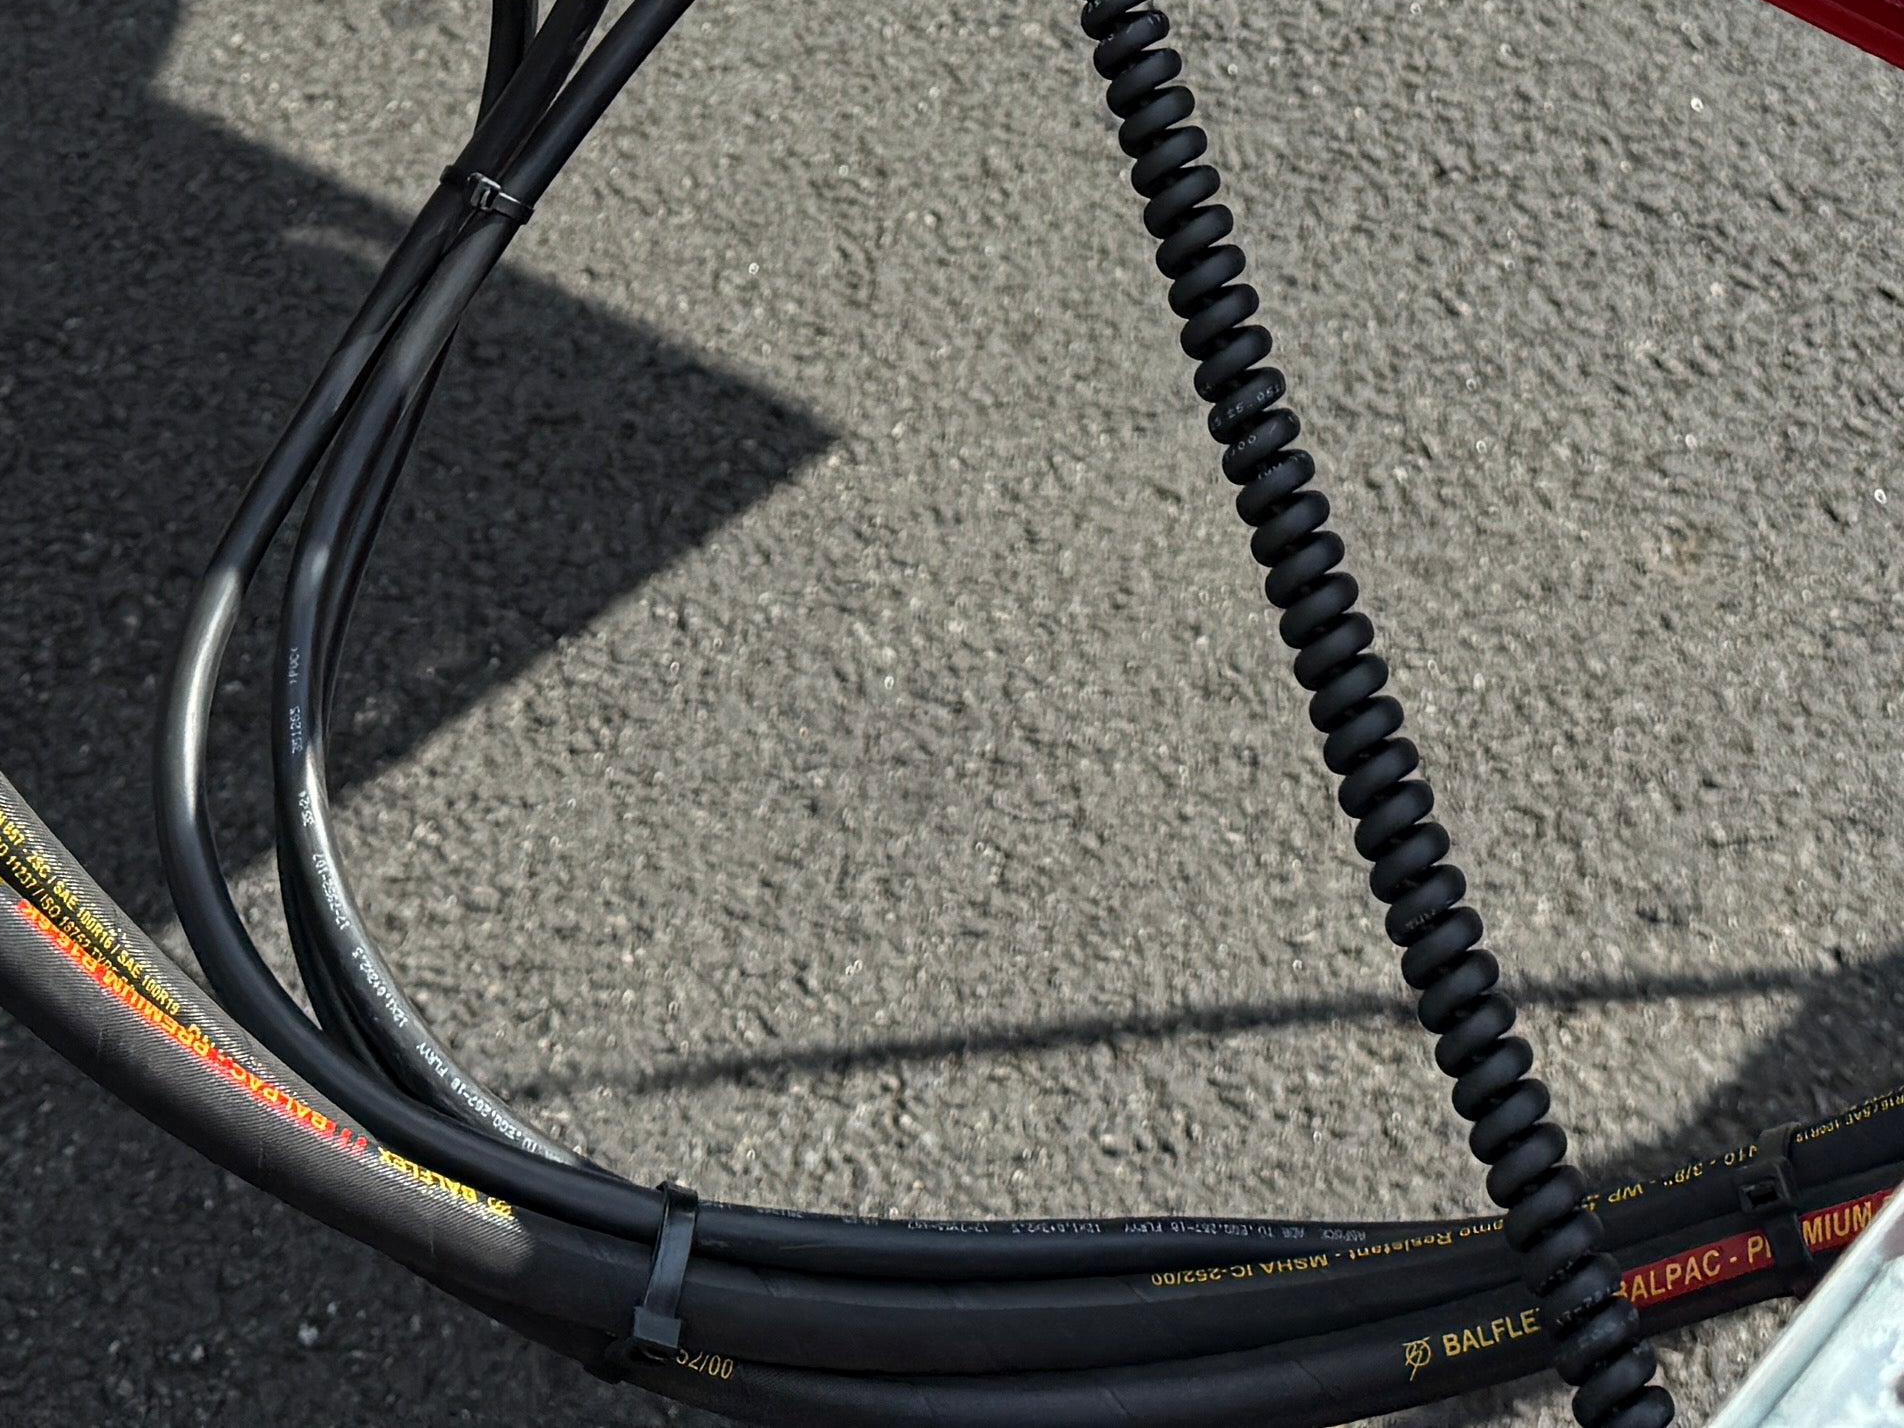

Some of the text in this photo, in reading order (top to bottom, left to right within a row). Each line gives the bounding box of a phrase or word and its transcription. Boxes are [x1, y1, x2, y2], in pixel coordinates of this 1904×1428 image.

[2, 853, 39, 892] 11237
[37, 892, 64, 919] ISO
[24, 849, 53, 880] 2SC
[51, 879, 81, 911] SAE
[74, 903, 118, 950] 100R16
[115, 947, 146, 979] SAE
[97, 960, 212, 1060] PREMIUM
[231, 1054, 330, 1133] BALPAC
[1607, 1178, 1645, 1208] WP
[1150, 1257, 1253, 1289] IC-252/00
[1258, 1250, 1329, 1275] MSHA
[1443, 1306, 1542, 1358] BALFLE
